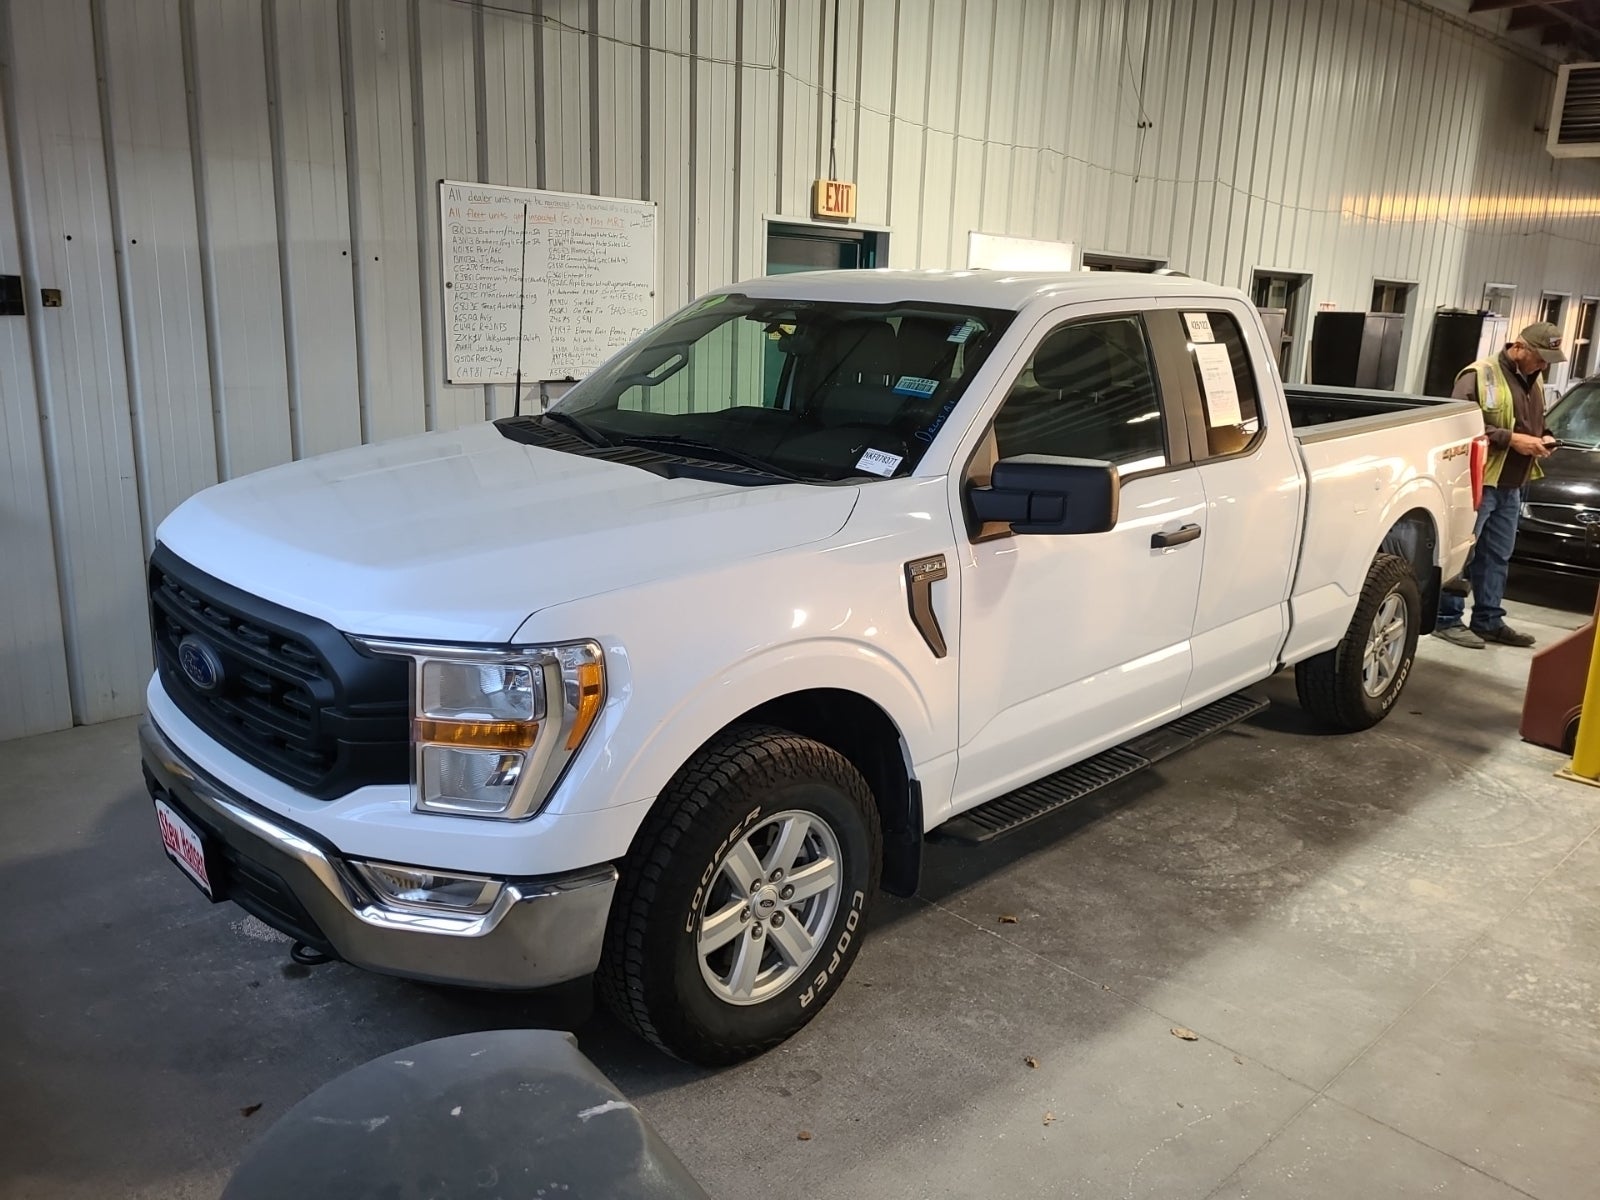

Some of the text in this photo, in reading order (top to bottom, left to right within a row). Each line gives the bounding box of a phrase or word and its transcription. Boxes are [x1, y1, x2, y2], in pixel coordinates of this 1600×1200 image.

[448, 187, 462, 201] All
[468, 190, 492, 202] dealer
[826, 182, 852, 213] EXIT
[448, 207, 461, 218] All
[466, 208, 487, 219] fleet
[685, 805, 762, 934] COOPER
[799, 890, 875, 1009] COOPER
